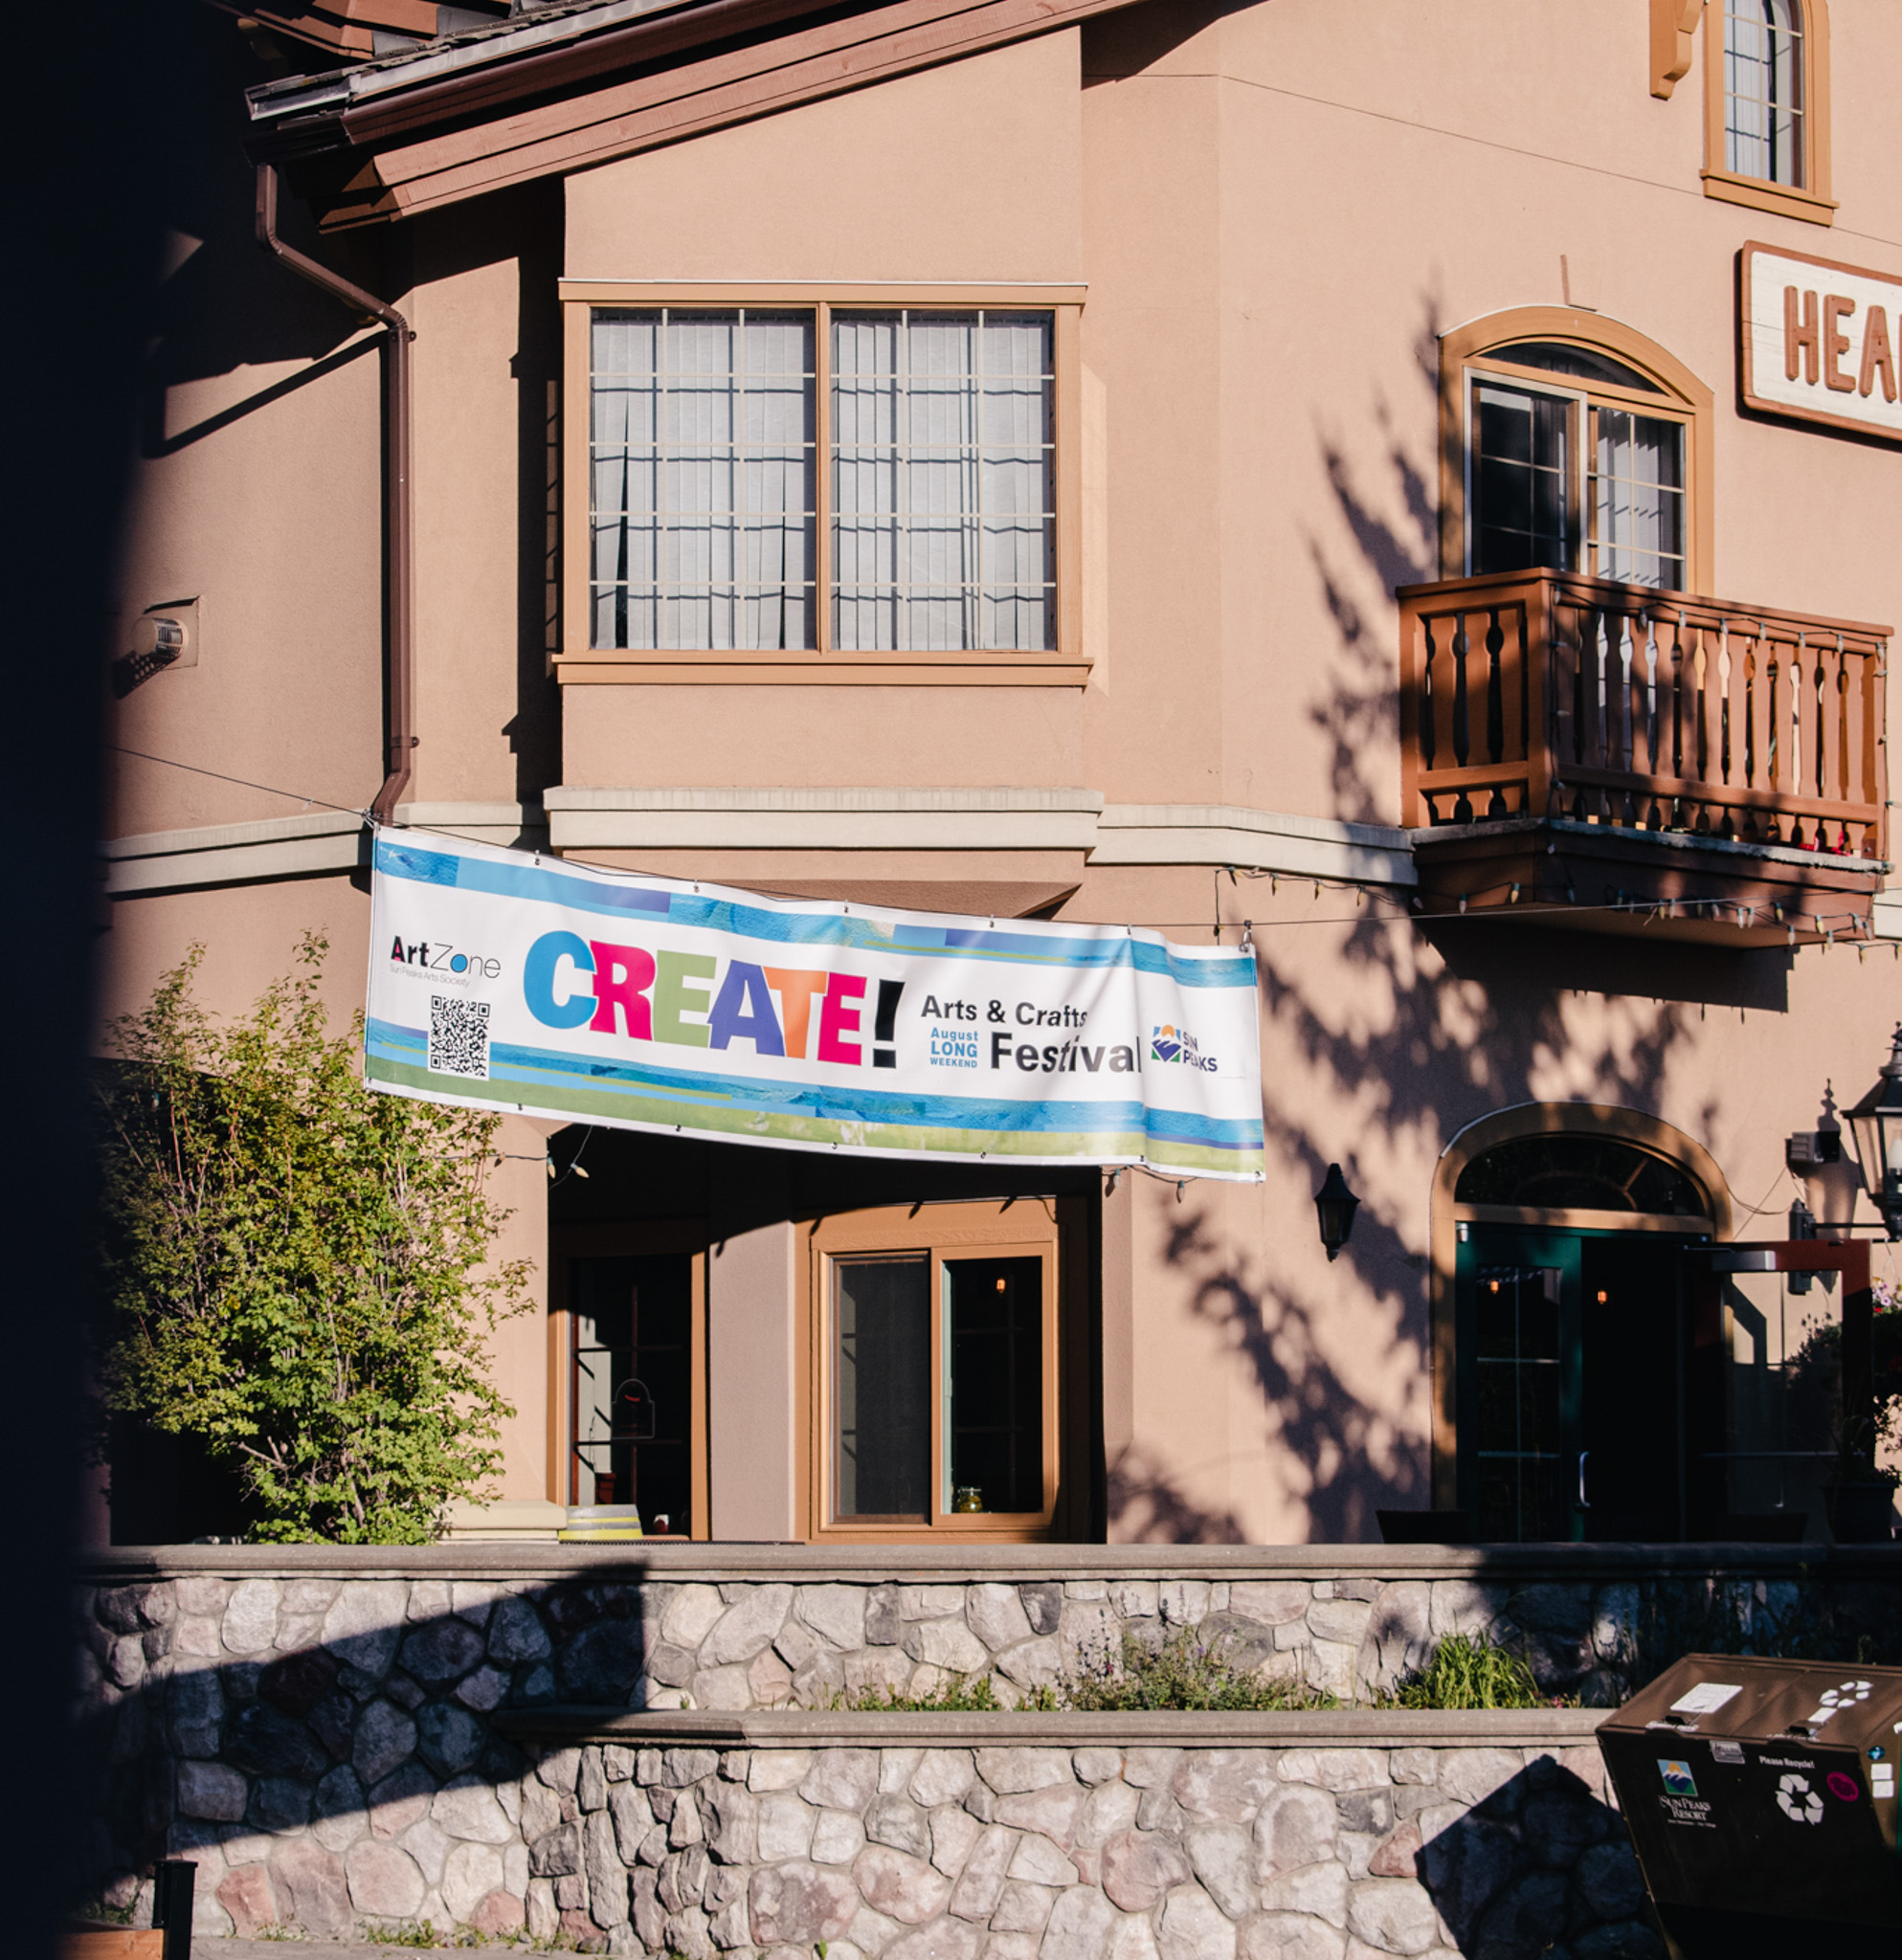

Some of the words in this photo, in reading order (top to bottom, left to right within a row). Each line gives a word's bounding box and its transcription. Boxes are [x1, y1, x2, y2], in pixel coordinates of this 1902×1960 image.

[1783, 284, 1902, 404] HEA
[424, 970, 439, 983] Arts
[440, 974, 471, 989] Society
[524, 929, 906, 1069] CREATE!
[921, 994, 977, 1021] Arts
[987, 999, 1006, 1024] &
[1016, 1001, 1088, 1028] Crafts
[930, 1027, 979, 1042] August
[930, 1040, 978, 1058] LONG
[991, 1031, 1142, 1073] Festival
[929, 1057, 978, 1069] WEEKEND
[1758, 1754, 1784, 1767] Please
[1783, 1757, 1816, 1770] Recycle!
